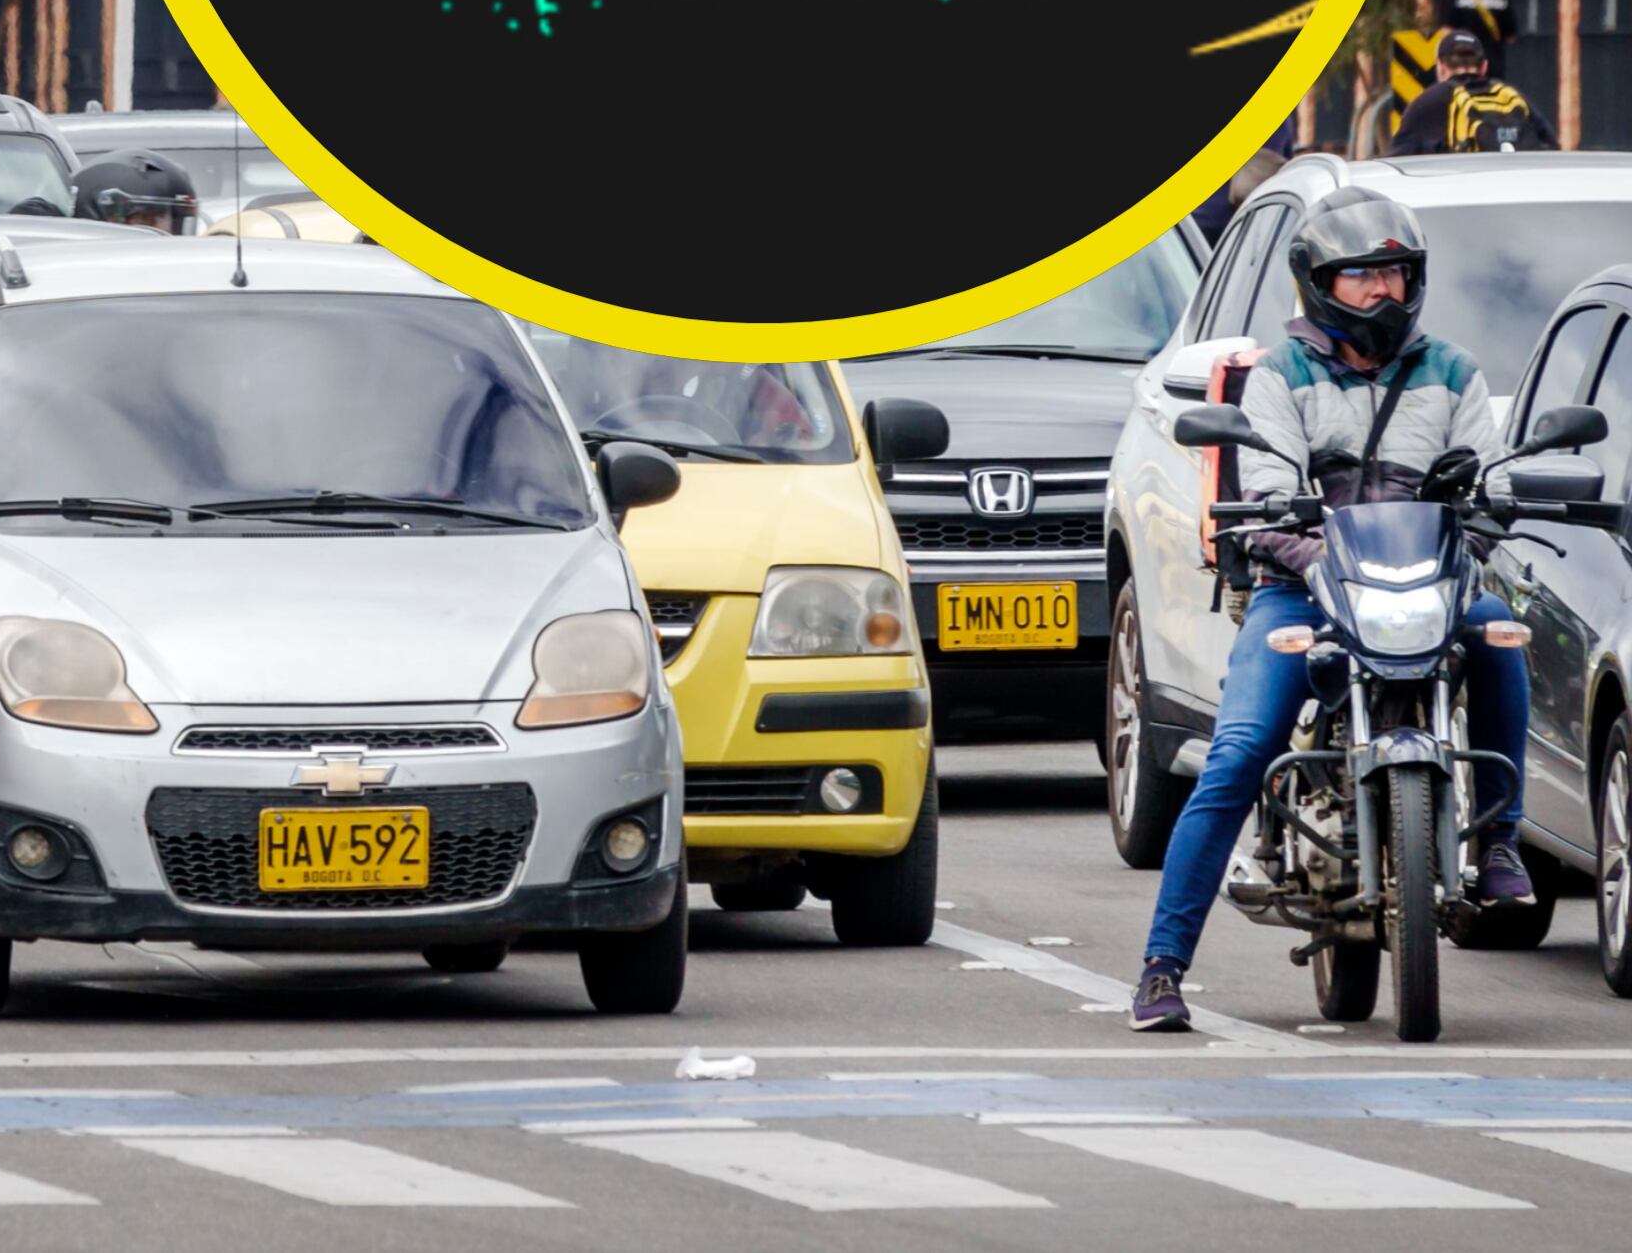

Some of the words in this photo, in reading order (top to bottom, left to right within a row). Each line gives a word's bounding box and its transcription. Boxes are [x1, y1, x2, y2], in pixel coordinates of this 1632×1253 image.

[948, 596, 1003, 631] IMN
[1013, 594, 1070, 629] 010
[267, 825, 337, 867] HAV
[350, 824, 421, 866] 592
[303, 870, 353, 883] BOGOTA
